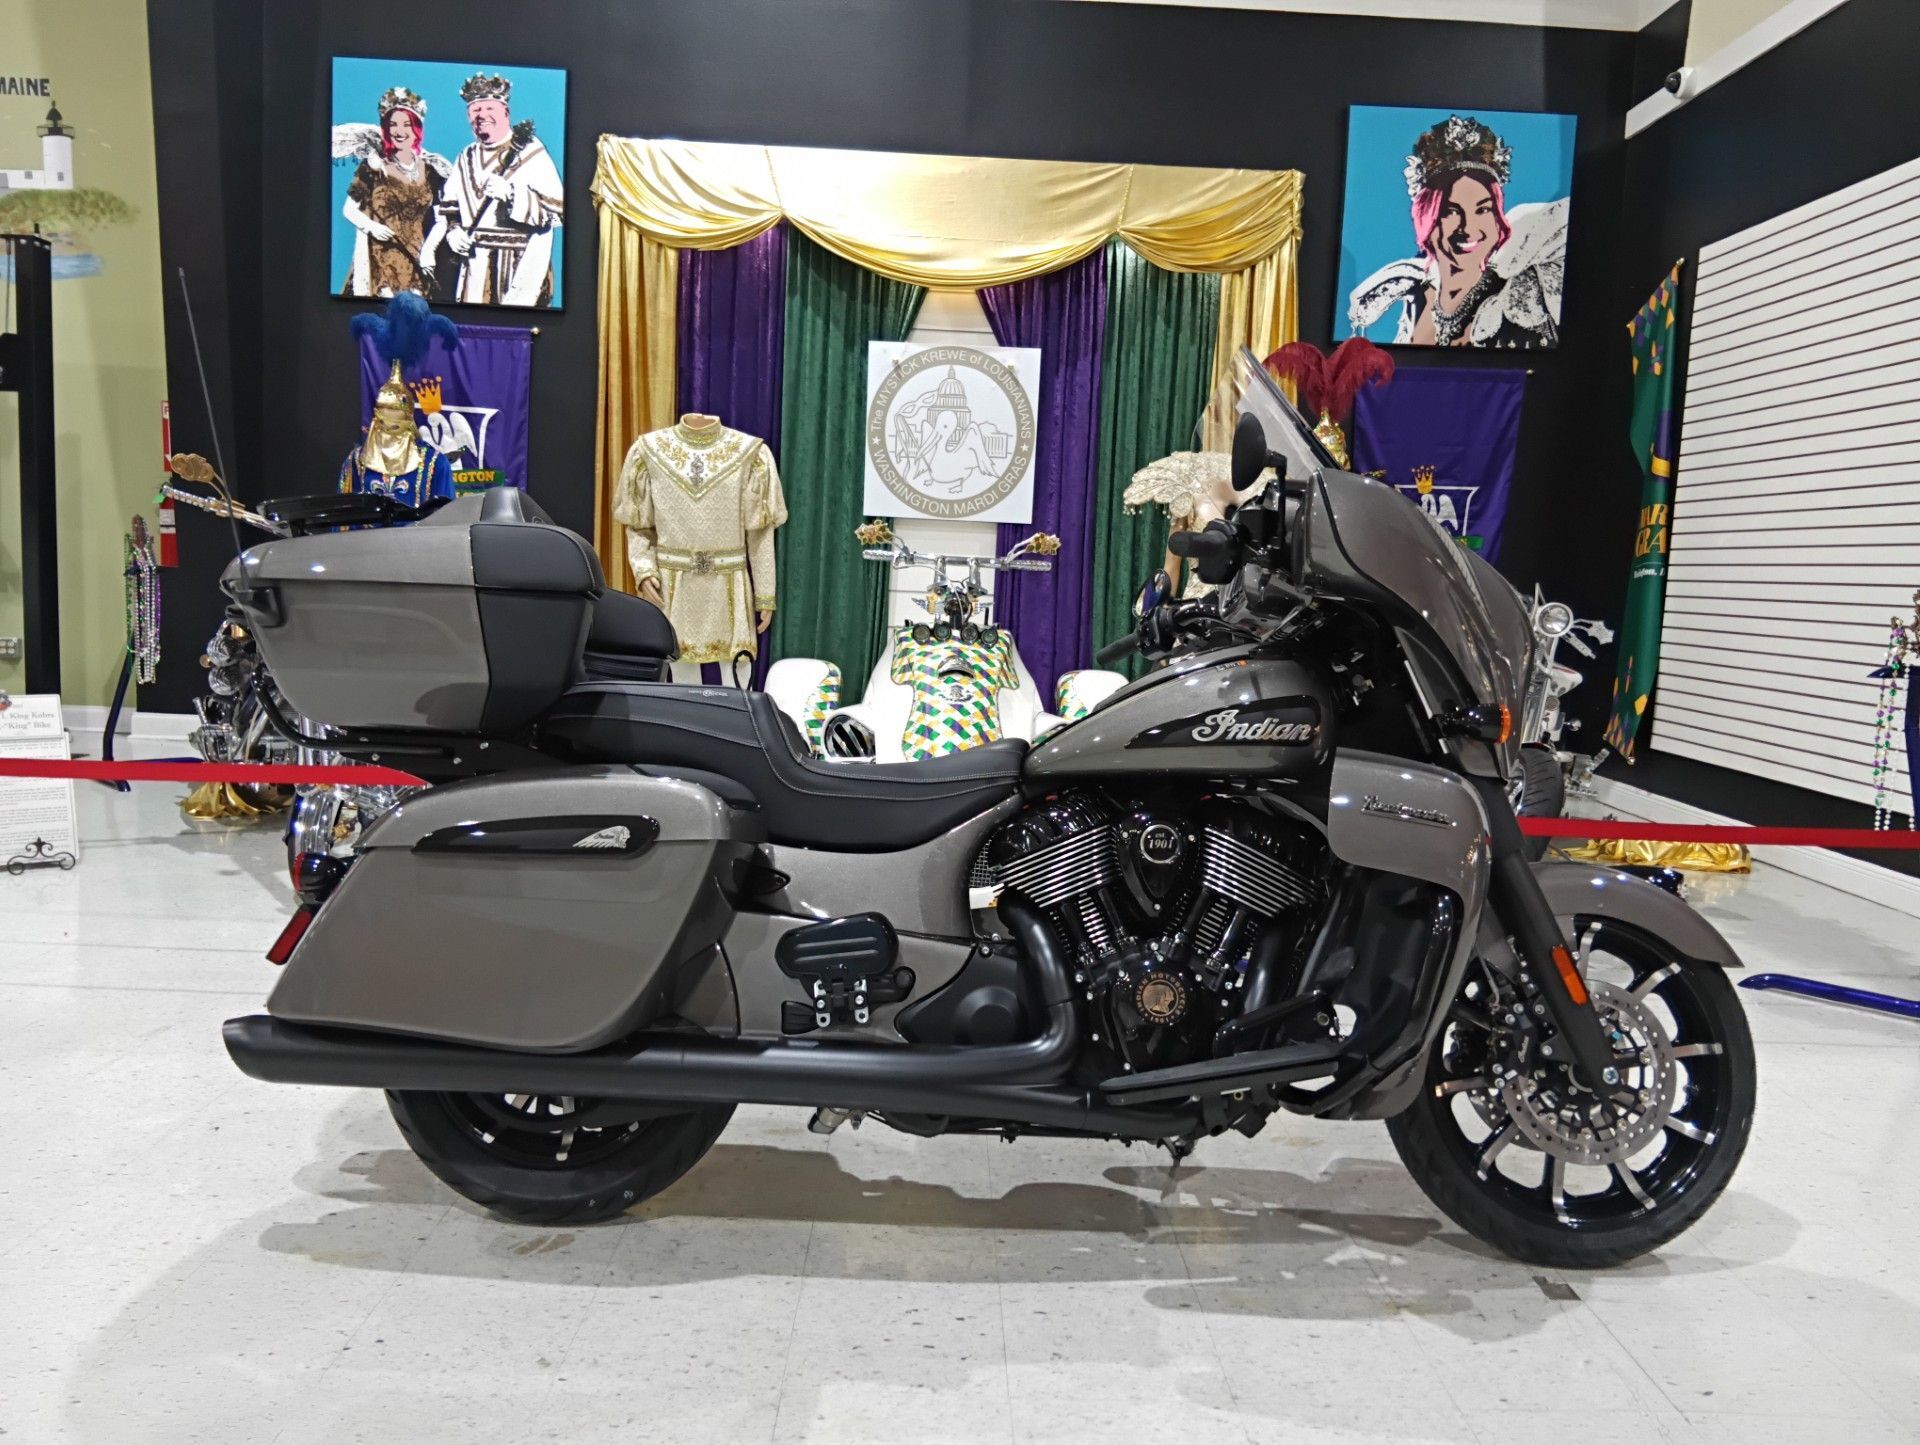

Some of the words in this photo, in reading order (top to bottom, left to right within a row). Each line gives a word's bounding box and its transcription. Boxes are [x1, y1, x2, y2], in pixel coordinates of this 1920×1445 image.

[921, 350, 967, 364] KREWE
[969, 354, 982, 364] of
[877, 360, 920, 406] MYSTICK
[871, 410, 884, 431] The
[873, 449, 950, 514] WASHINGTON
[954, 491, 998, 515] MARDI
[1000, 456, 1027, 493] GRAS
[1191, 709, 1312, 742] Indian
[1149, 839, 1173, 849] 1901
